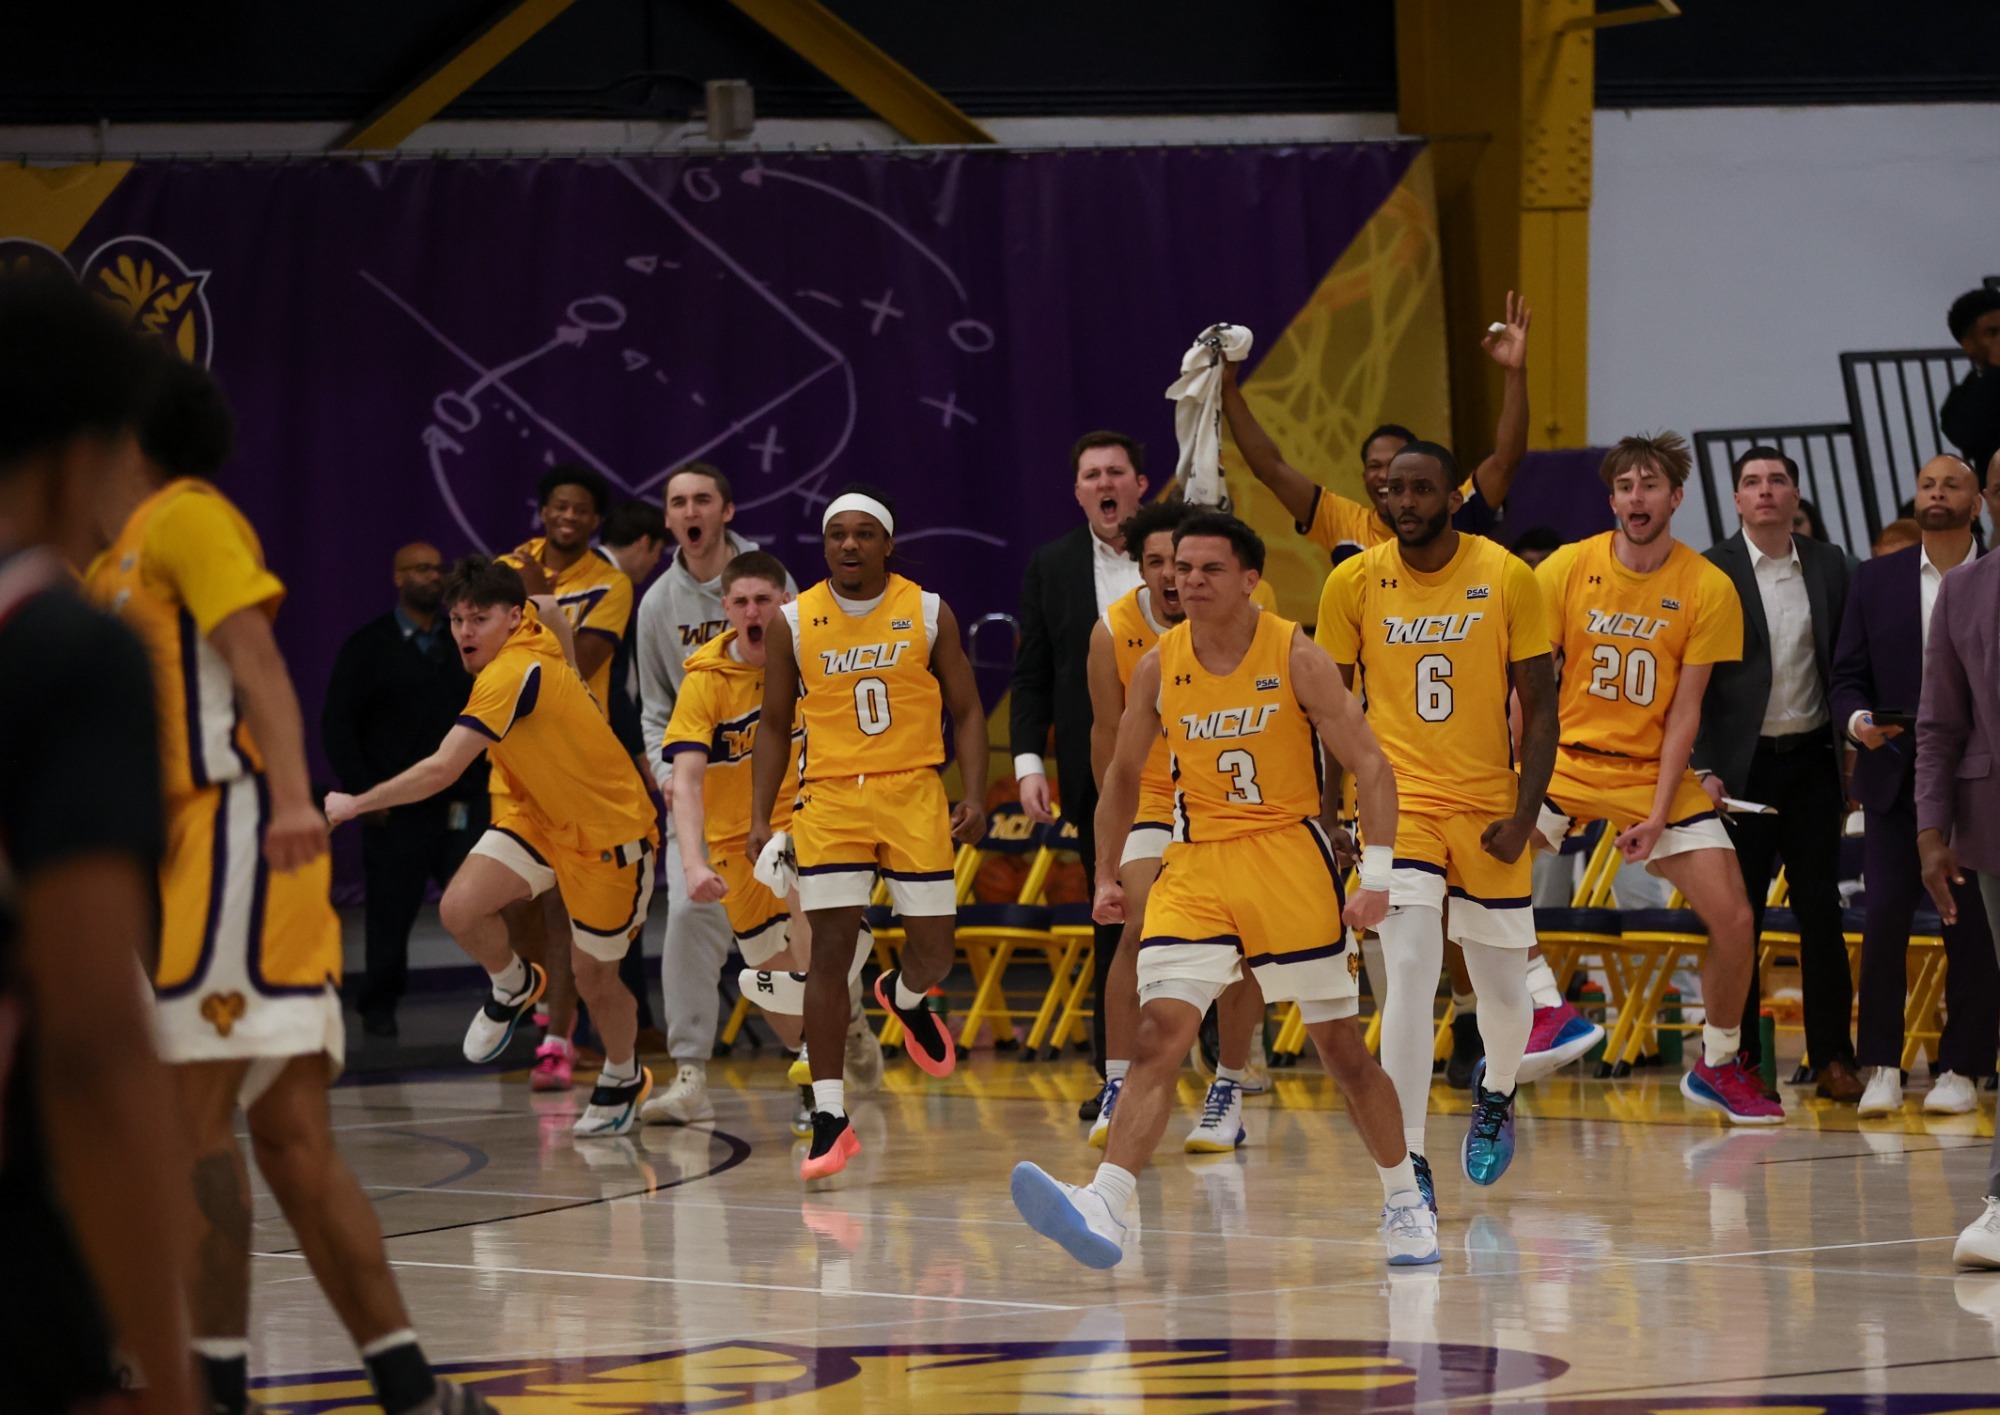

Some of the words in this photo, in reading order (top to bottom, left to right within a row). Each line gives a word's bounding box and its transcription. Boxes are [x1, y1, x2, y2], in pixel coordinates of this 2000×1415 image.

[1466, 587, 1490, 597] PSAC
[678, 619, 730, 646] WC
[891, 620, 912, 628] PSAC
[1382, 611, 1484, 645] WCU
[1586, 608, 1670, 641] WCU
[819, 640, 911, 676] WCU
[1587, 643, 1657, 708] 20
[1256, 677, 1279, 688] PSAC
[1416, 653, 1454, 723] 6
[853, 676, 892, 736] 0
[1179, 703, 1280, 740] WCU
[1216, 748, 1264, 805] 3
